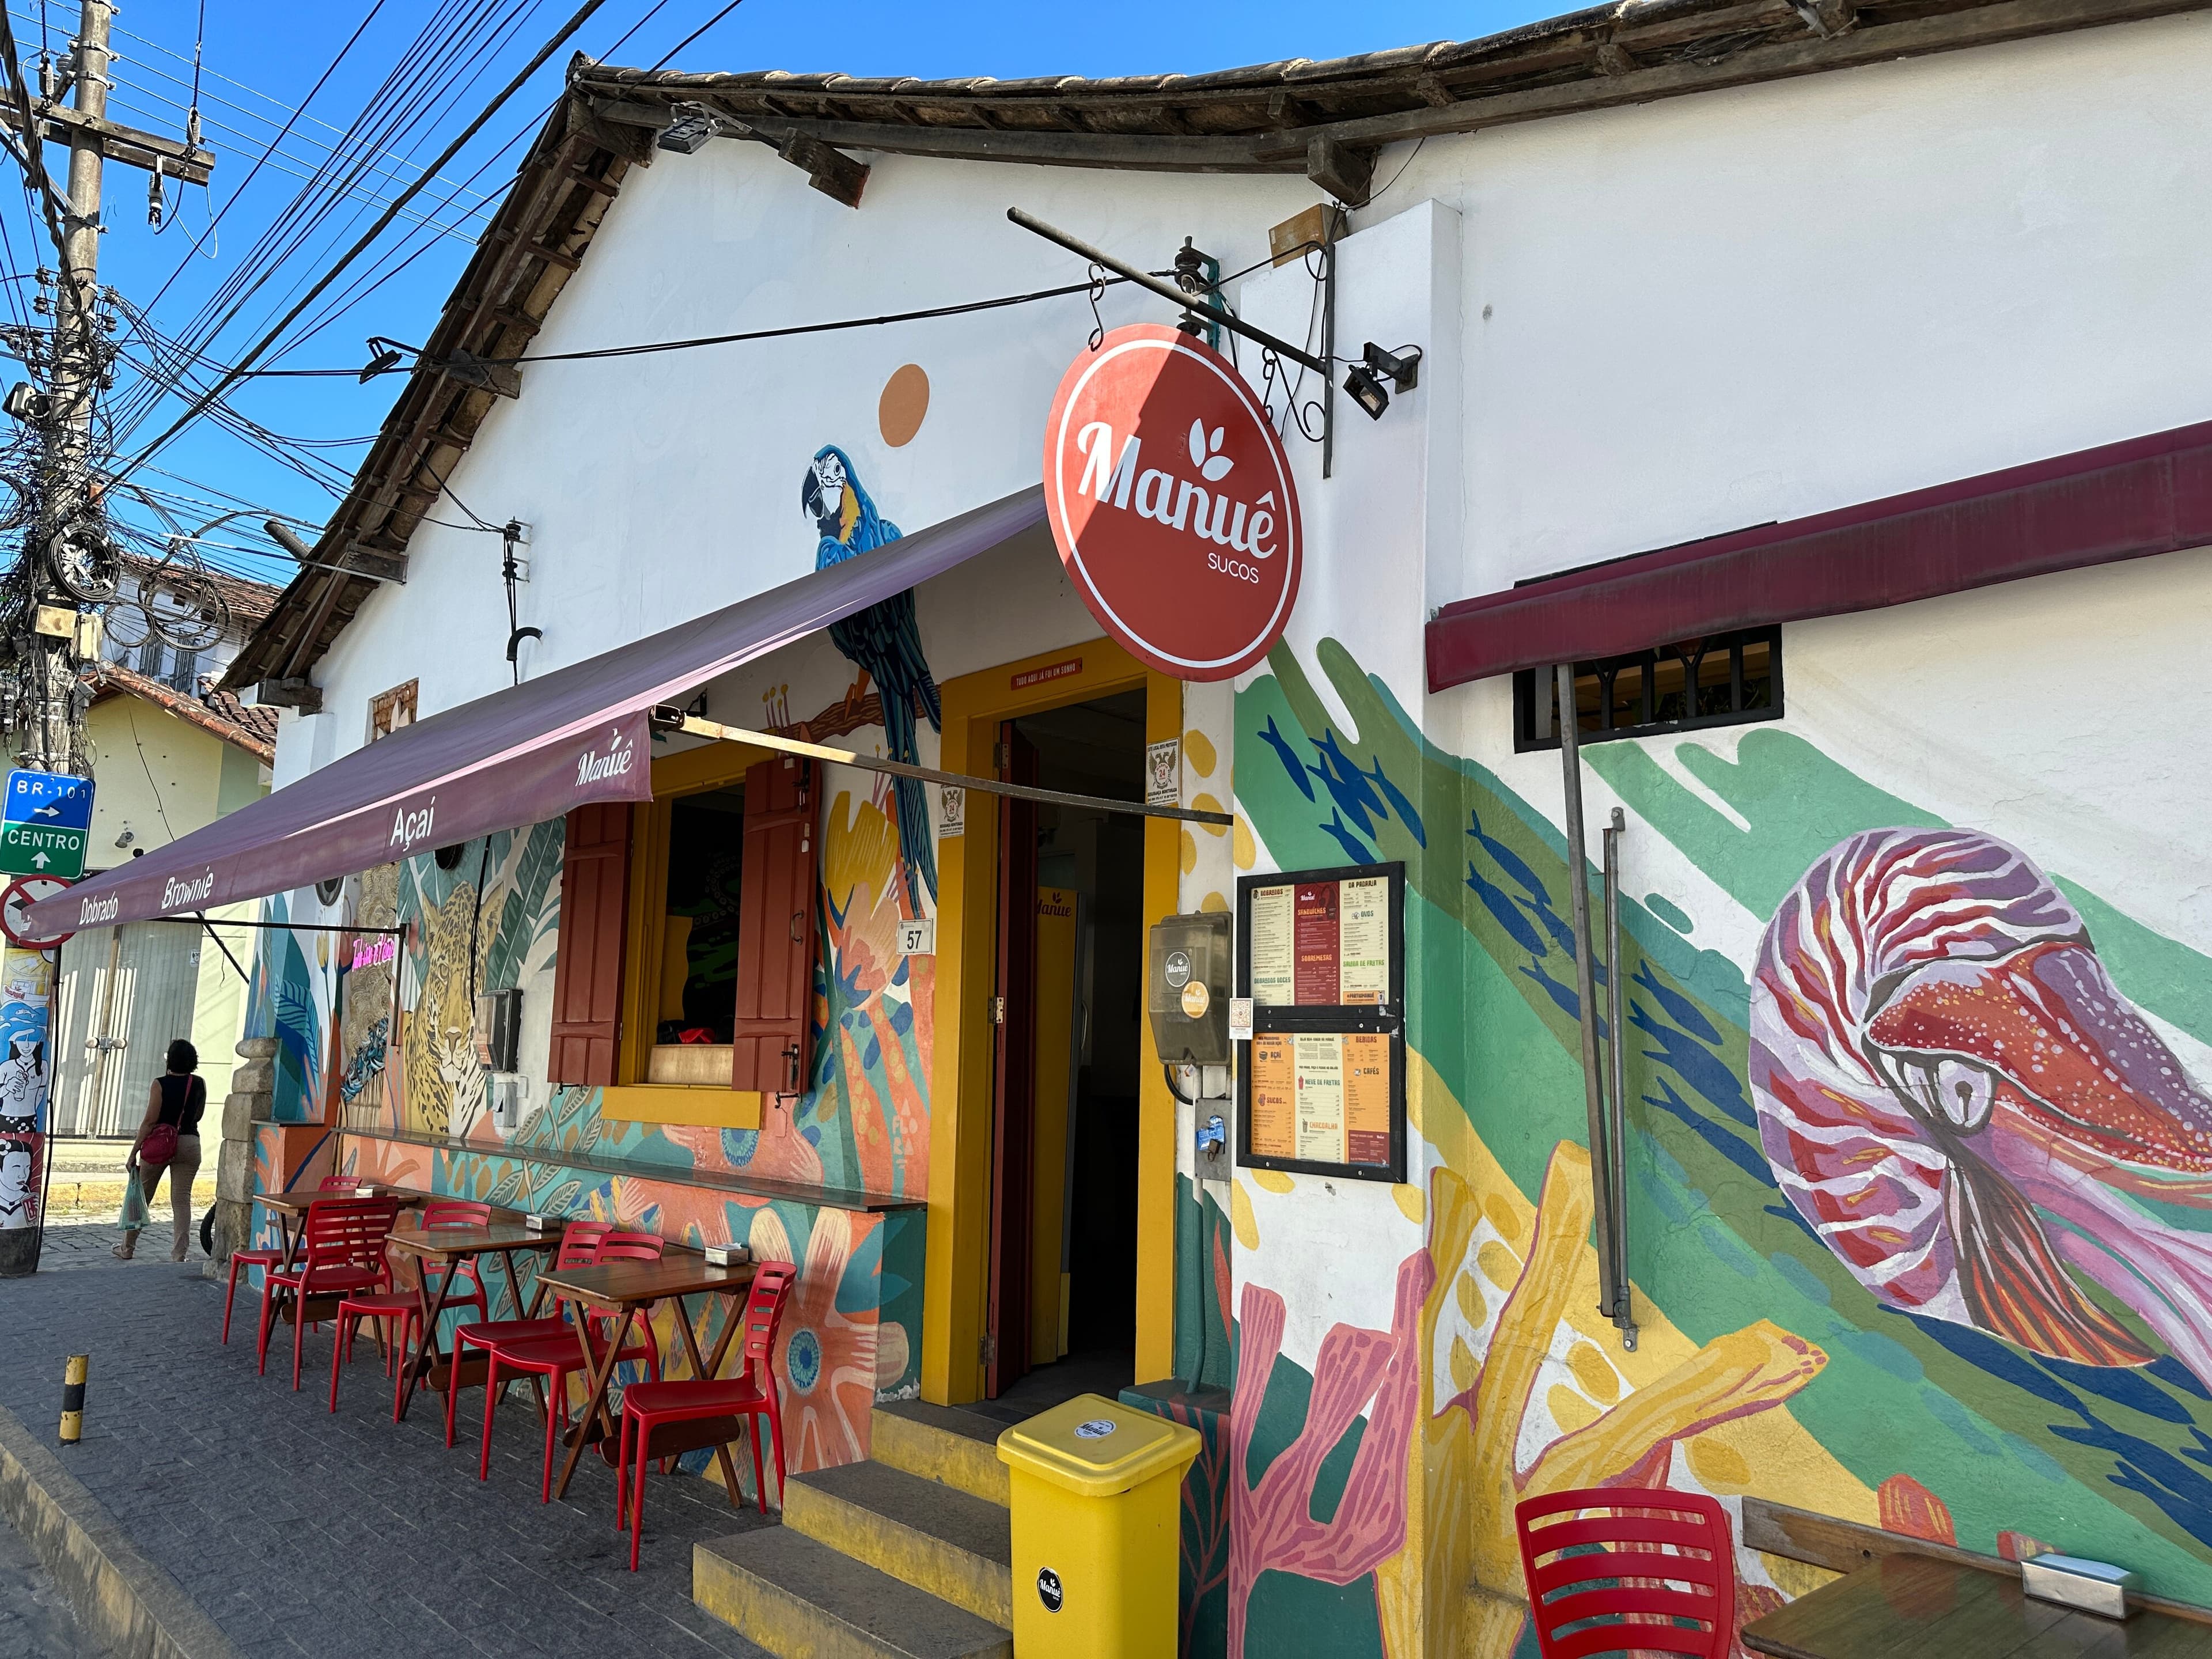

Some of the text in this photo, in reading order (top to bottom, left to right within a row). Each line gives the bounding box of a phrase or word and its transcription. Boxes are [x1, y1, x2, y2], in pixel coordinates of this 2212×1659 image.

[1077, 422, 1277, 559] Manuê
[1207, 552, 1259, 584] SUCOS
[1016, 676, 1027, 687] TUDO
[1028, 674, 1037, 683] AQUI
[1039, 669, 1044, 680] JÁ
[1053, 668, 1060, 676] UM
[1061, 663, 1075, 675] SONHO
[575, 739, 632, 786] Manuê
[1159, 768, 1165, 777] 24
[17, 780, 86, 799] BR-101
[949, 804, 955, 812] 24
[390, 796, 436, 851] Açaí
[8, 830, 79, 850] CENTRO
[1356, 880, 1377, 888] PADARIA
[79, 891, 119, 925] Dobrado
[1297, 907, 1326, 916] SANDUÍCHES
[907, 930, 922, 950] 57
[1301, 954, 1332, 962] SOBREMESAS
[1167, 963, 1188, 974] Manuê
[1271, 1050, 1282, 1059] AÇAÍ
[1363, 1066, 1380, 1075] CAFÉS
[1039, 1579, 1061, 1597] Manuê
